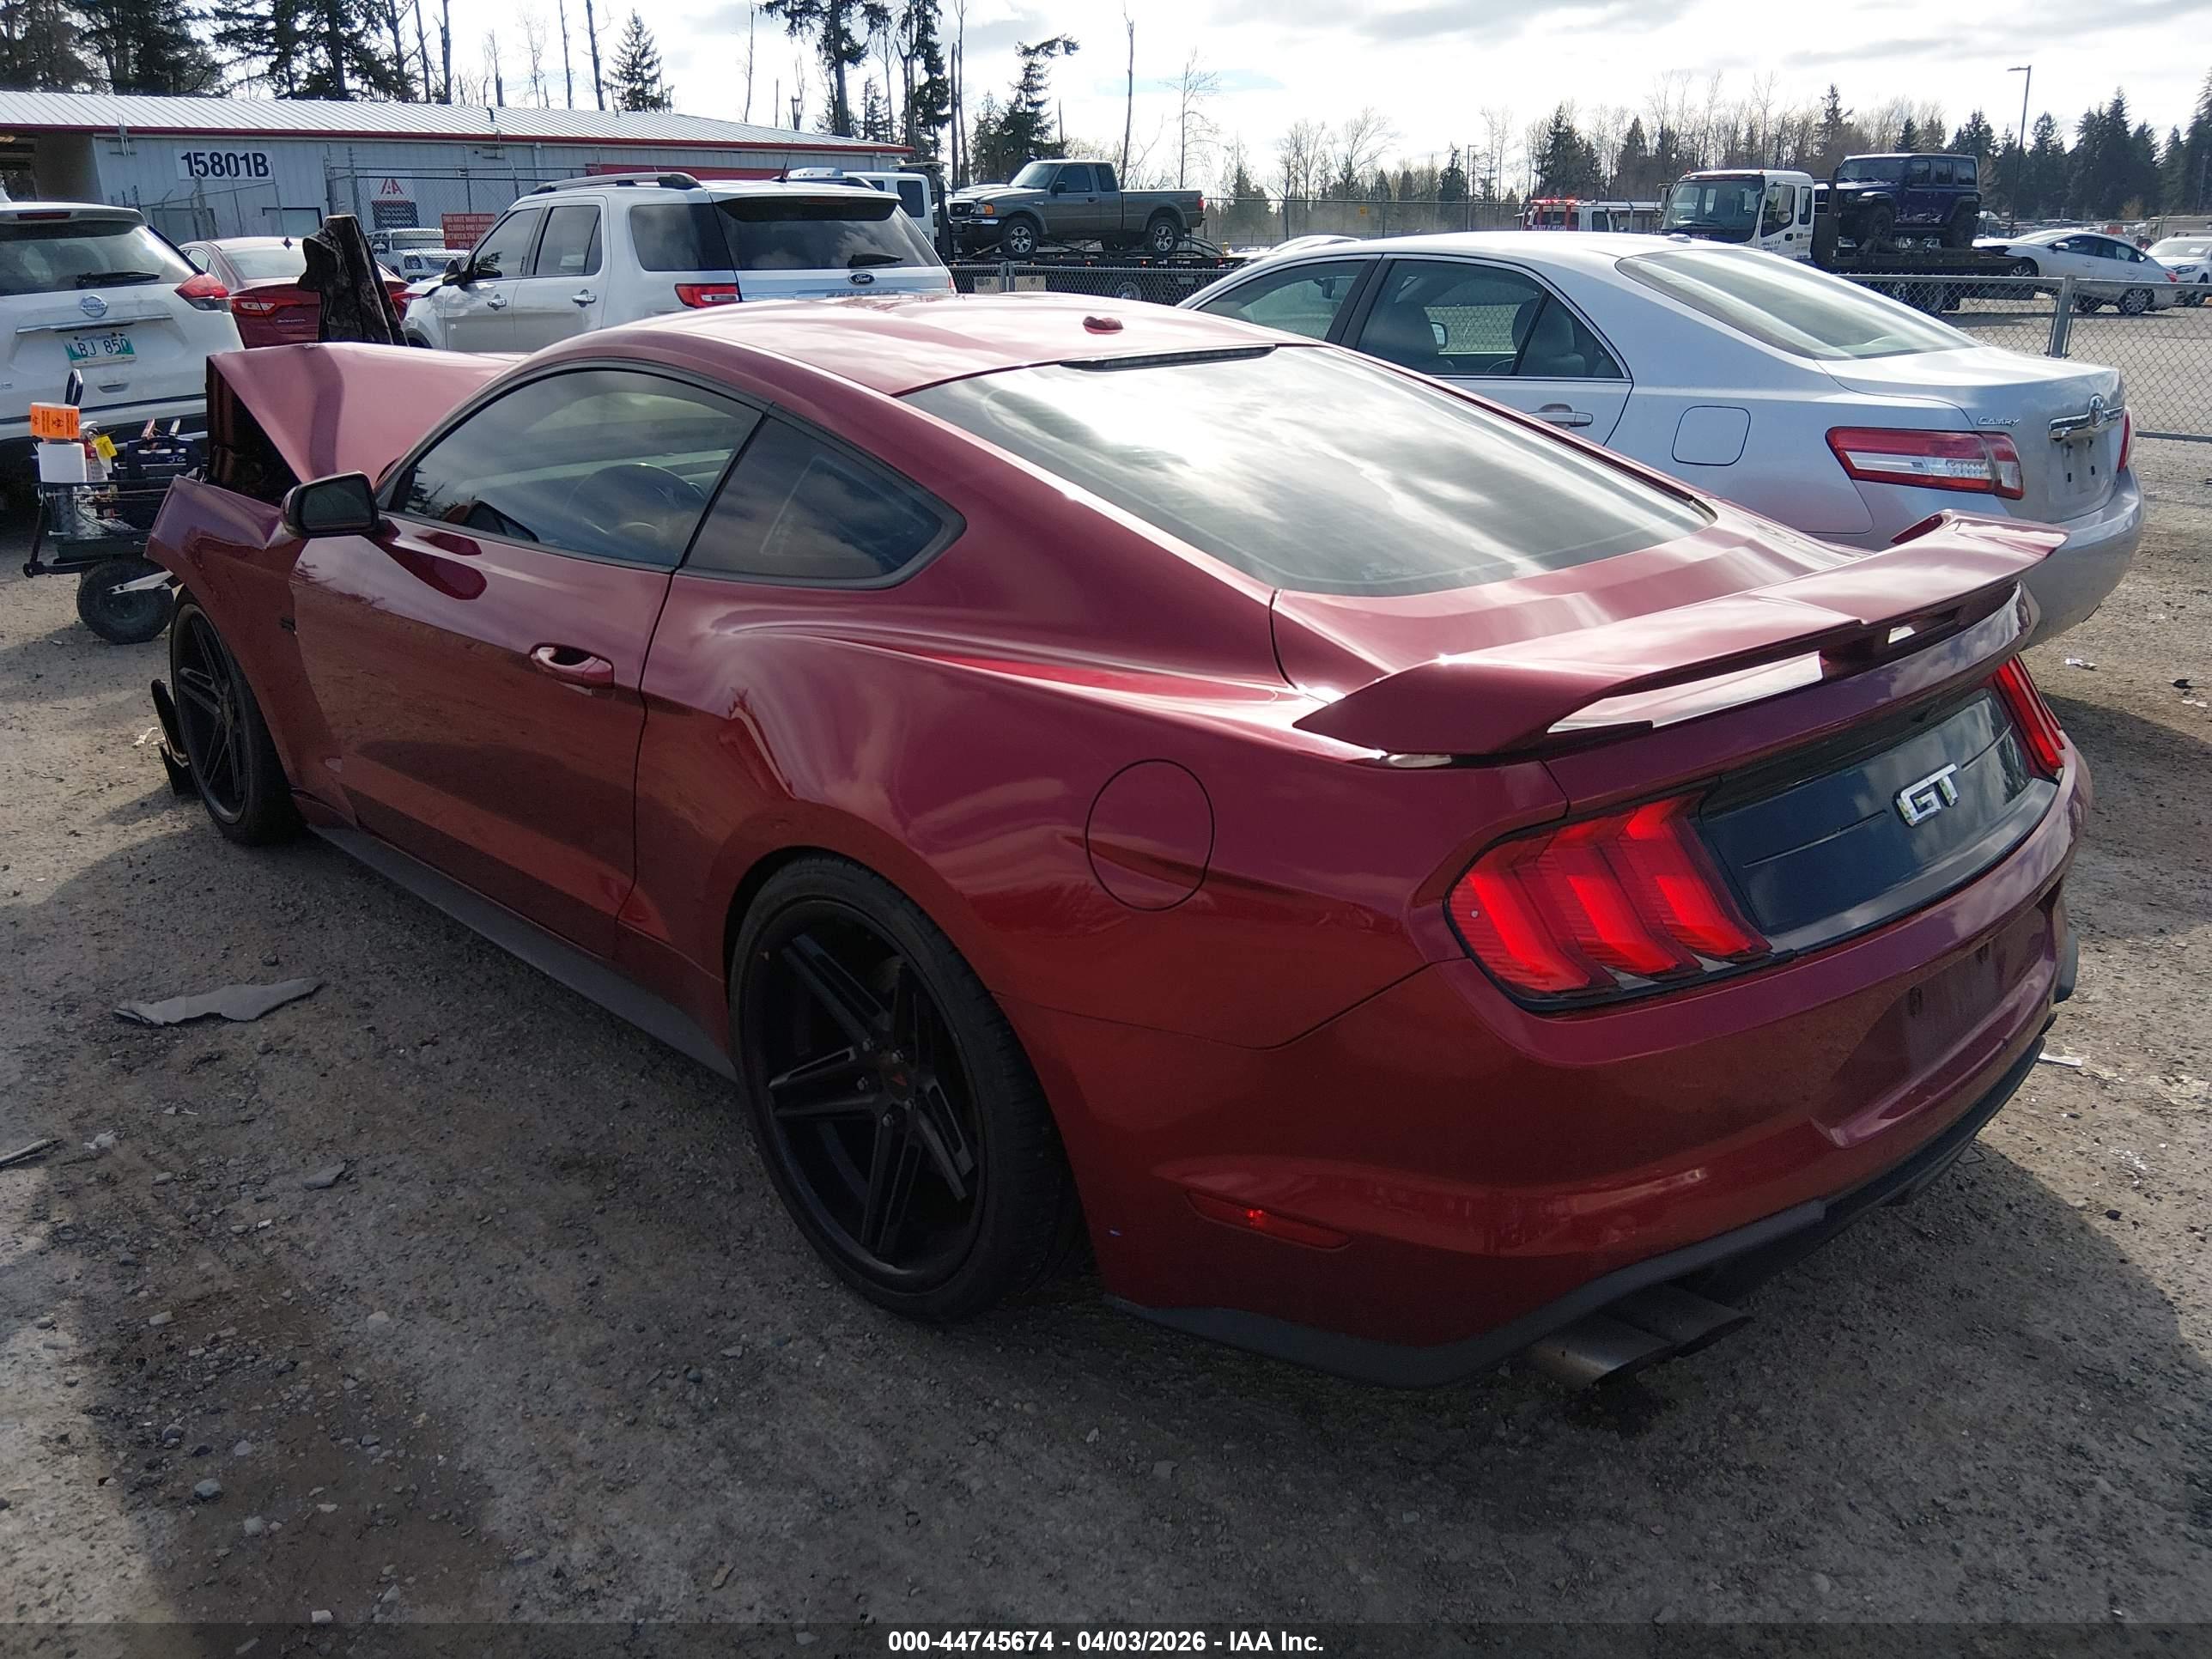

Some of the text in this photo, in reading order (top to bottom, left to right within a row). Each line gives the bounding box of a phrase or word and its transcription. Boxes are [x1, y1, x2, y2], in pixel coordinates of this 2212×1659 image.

[180, 151, 270, 178] 15801B
[854, 274, 870, 283] Ford
[69, 341, 97, 358] LBJ
[103, 337, 129, 354] 850
[1895, 763, 1958, 826] GT
